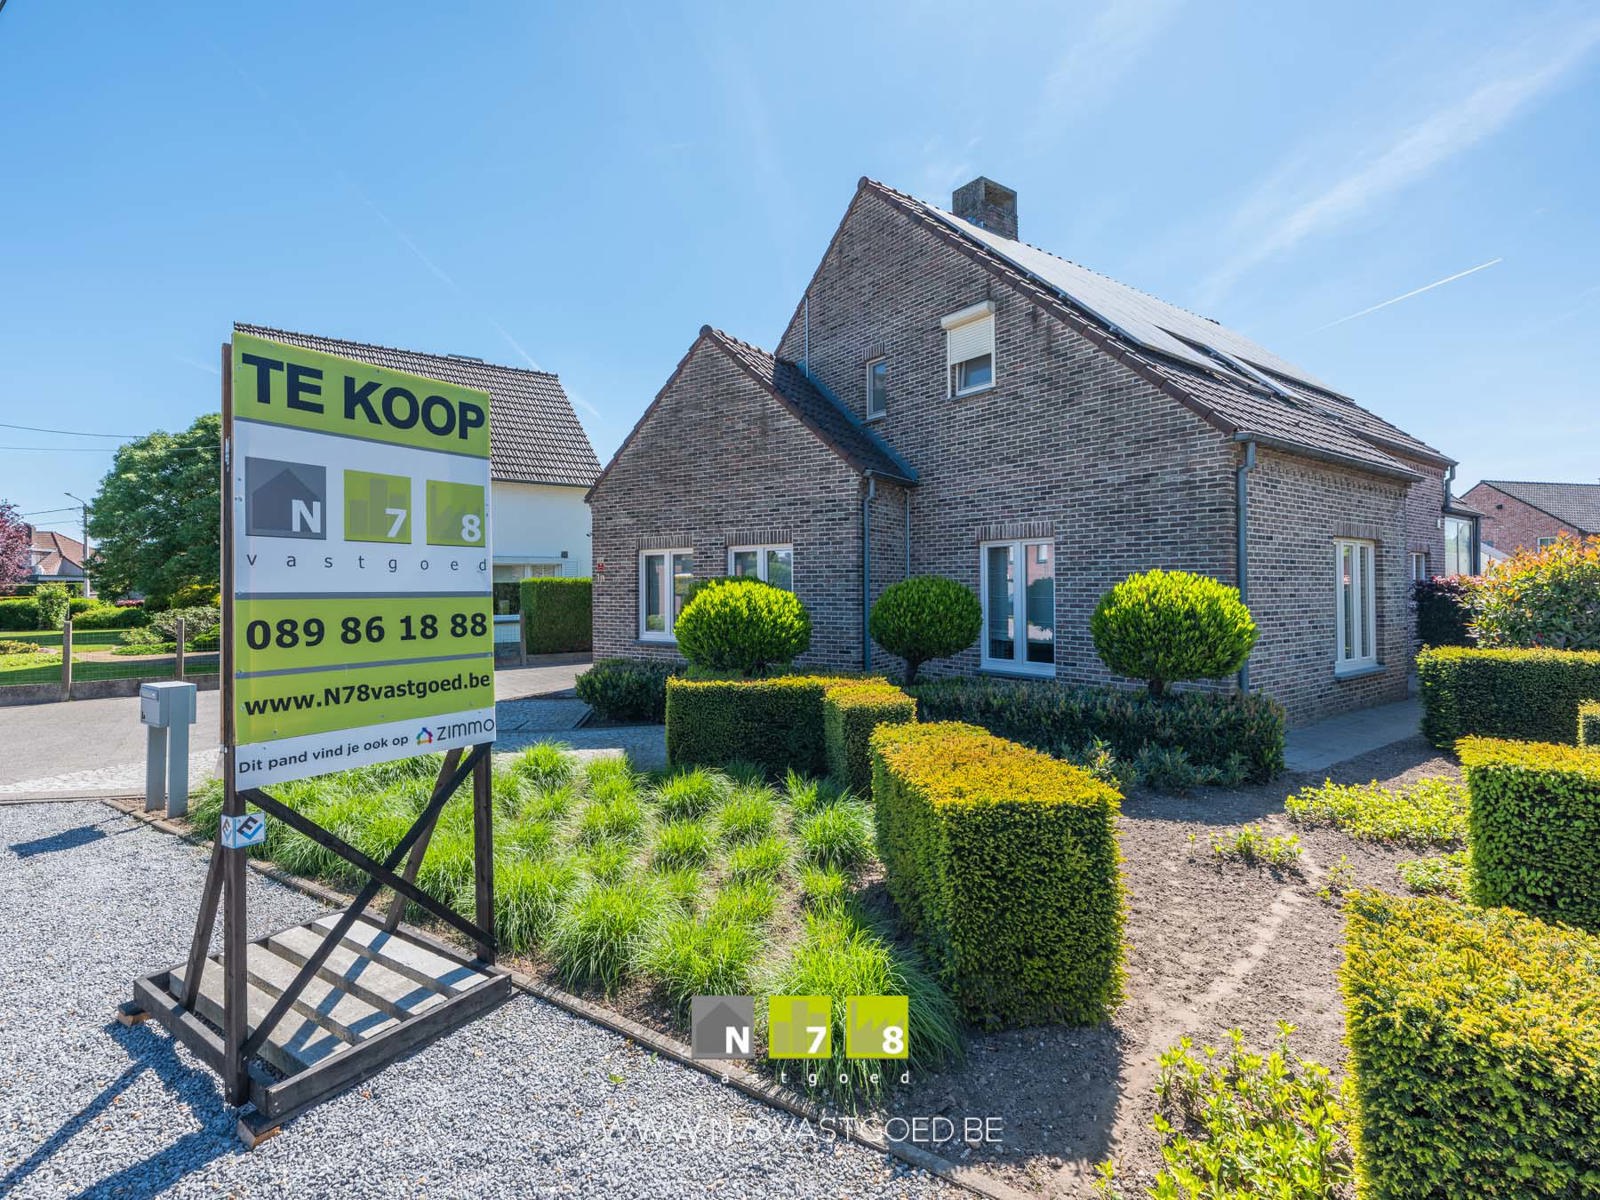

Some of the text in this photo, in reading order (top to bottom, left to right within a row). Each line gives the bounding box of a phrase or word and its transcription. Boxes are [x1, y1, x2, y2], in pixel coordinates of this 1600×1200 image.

[241, 352, 485, 440] TE KOOP
[291, 499, 481, 542] N 7 8
[246, 612, 487, 650] 089 86 18 88
[244, 672, 491, 716] www.N78vastgoed.be
[239, 759, 262, 774] Dit
[268, 751, 308, 770] pand
[312, 745, 343, 760] vind
[347, 743, 360, 756] je
[363, 738, 388, 751] ook
[392, 736, 409, 747] op
